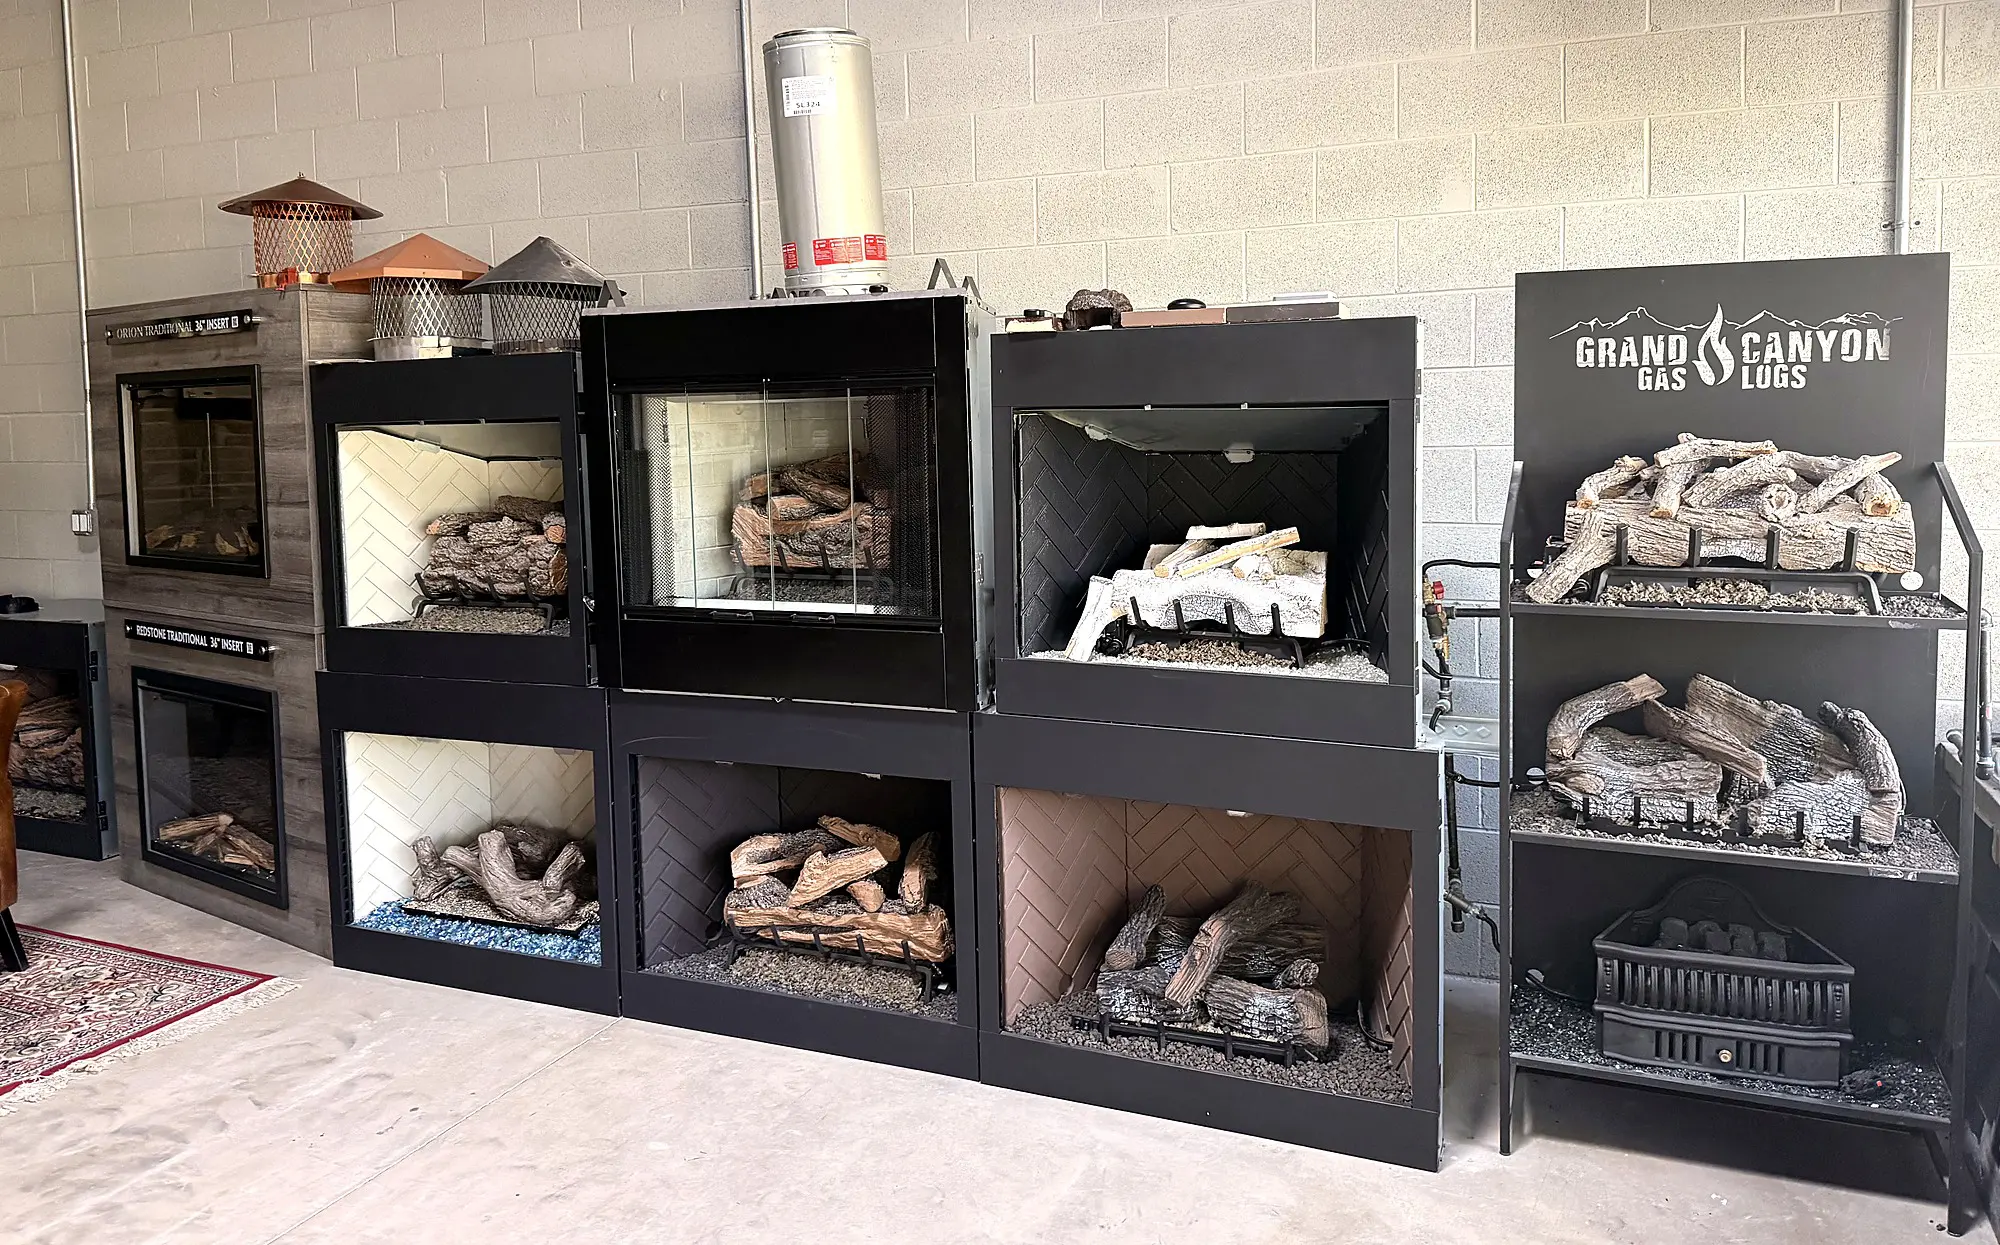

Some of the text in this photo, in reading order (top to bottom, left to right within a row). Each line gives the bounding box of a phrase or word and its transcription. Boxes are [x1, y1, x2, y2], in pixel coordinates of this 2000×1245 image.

[116, 317, 230, 340] ORION TRADITIONAL 36" INSERT
[1575, 328, 1890, 368] GRAND CANYON
[1637, 364, 1808, 392] GAS LOGS
[136, 625, 244, 653] REDSTONE TRADITIONAL 36" INSERT
